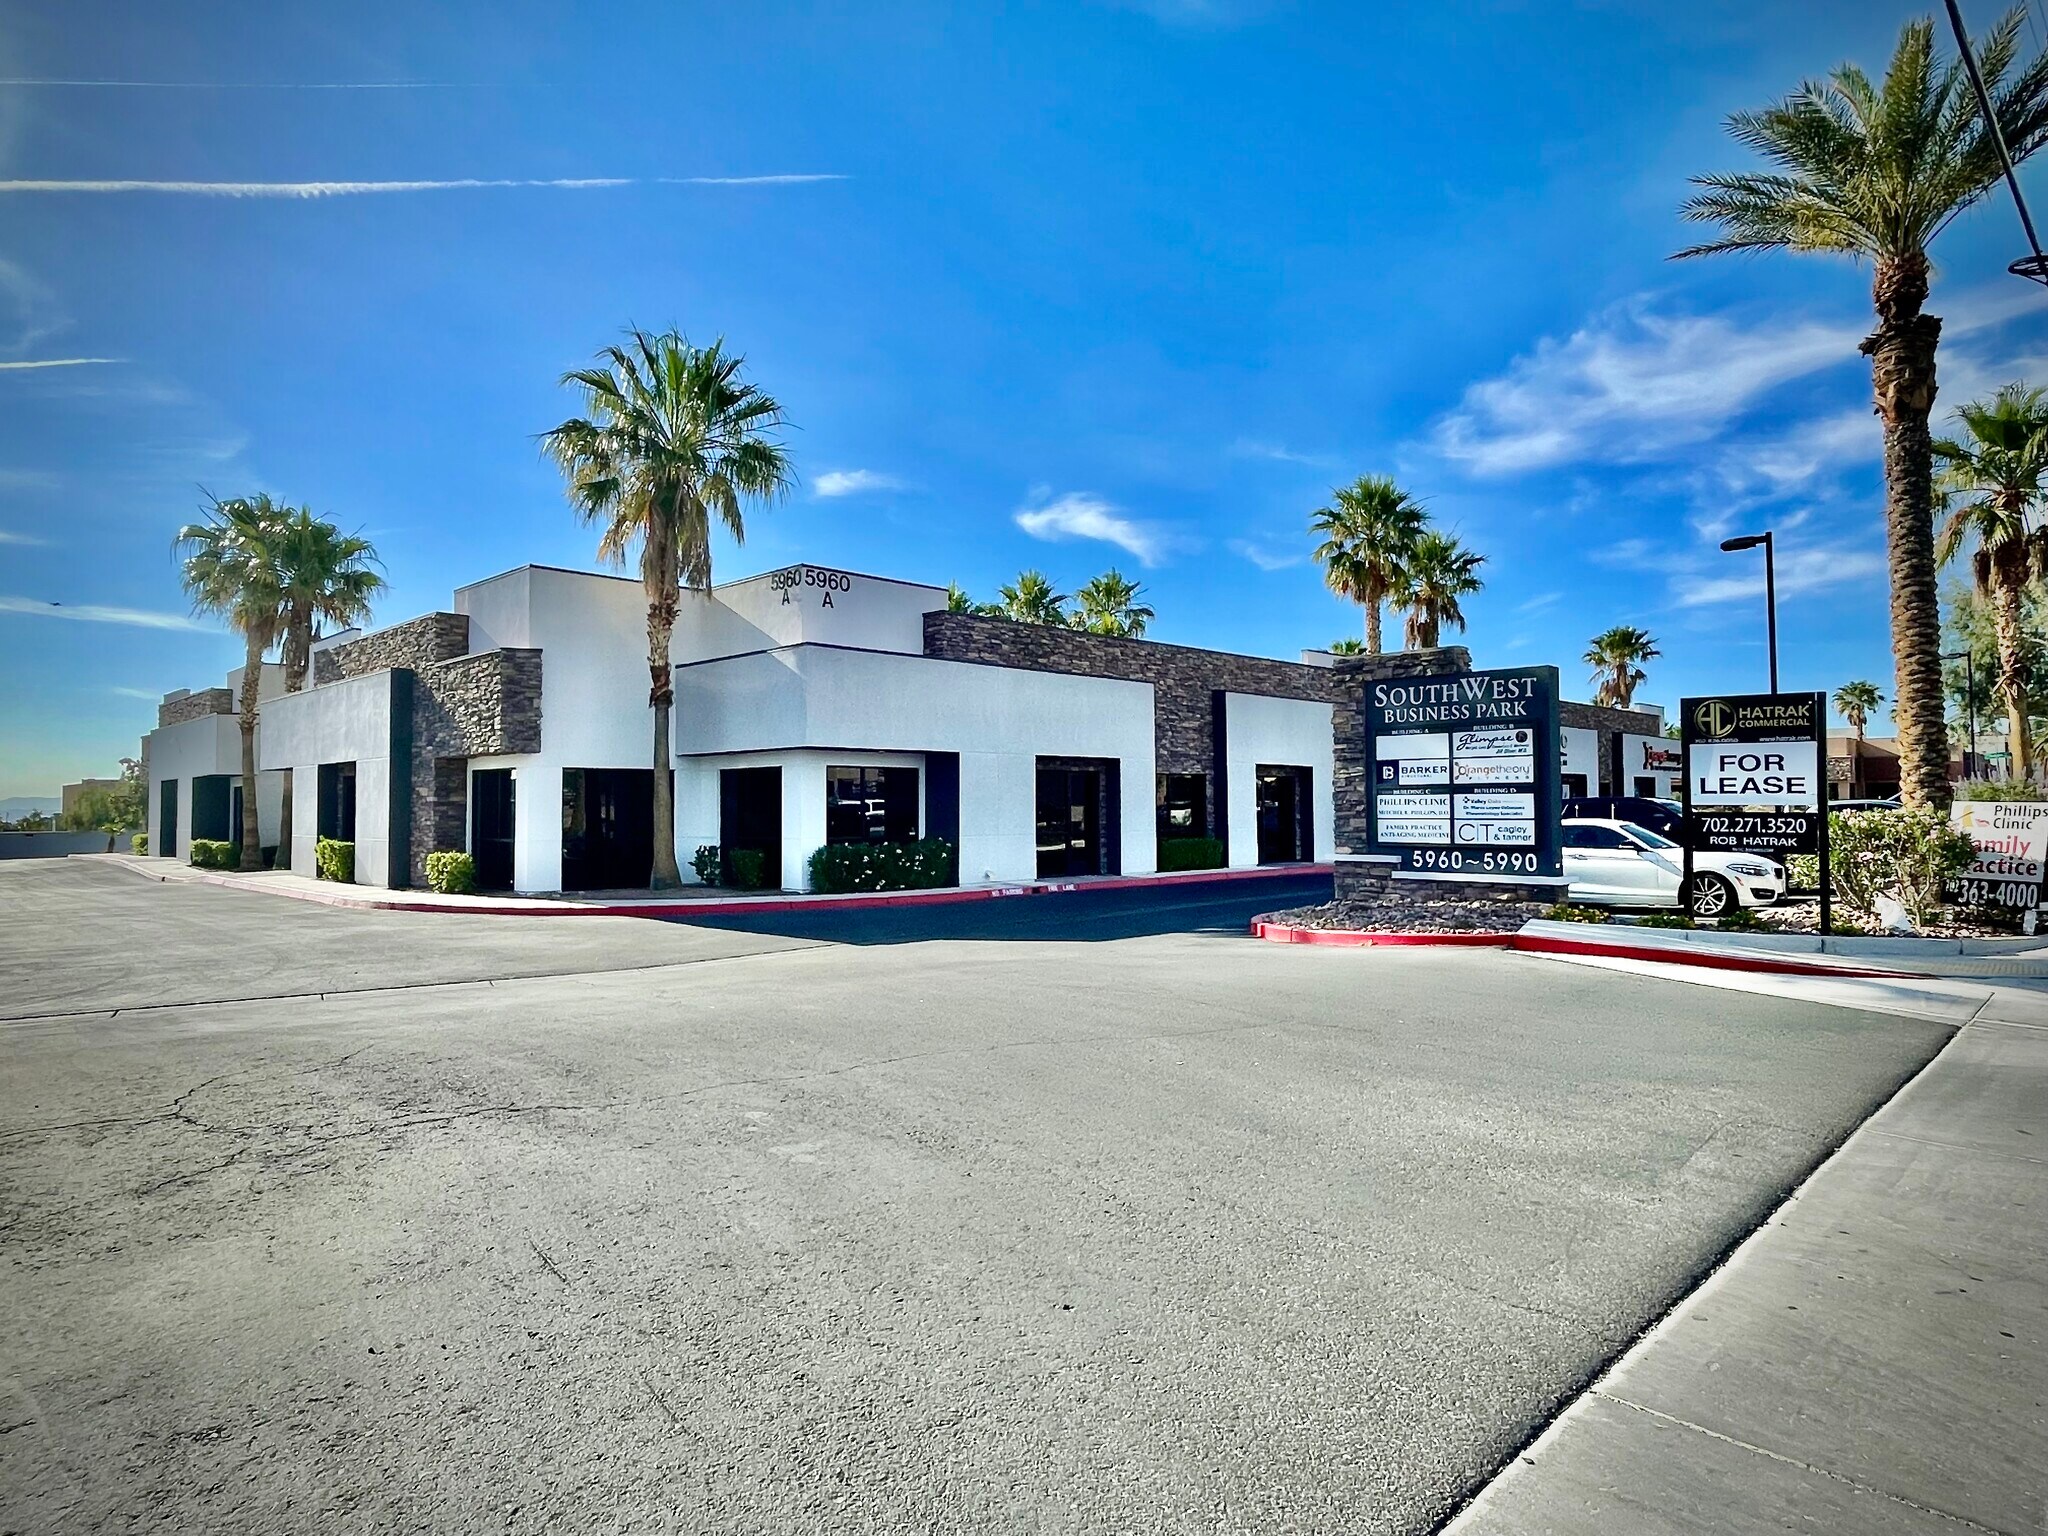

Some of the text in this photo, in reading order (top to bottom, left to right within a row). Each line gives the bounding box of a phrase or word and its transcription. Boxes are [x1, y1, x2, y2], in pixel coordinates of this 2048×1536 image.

[771, 569, 801, 591] 5960
[804, 569, 850, 592] 5960
[782, 589, 790, 606] A
[822, 591, 834, 608] A
[1384, 701, 1527, 723] BUSINESS PARK
[1739, 705, 1810, 719] HATRAK
[1739, 718, 1810, 728] COMMERCIAL
[1456, 733, 1514, 751] Glimpse
[1401, 766, 1448, 774] BARKER
[1719, 754, 1785, 772] FOR
[1700, 776, 1807, 795] LEASE
[1994, 805, 2048, 819] Phillips
[1498, 826, 1527, 834] cagley
[1702, 817, 1807, 834] 702.271.3520
[1993, 818, 2033, 830] Clinic
[1710, 836, 1797, 847] ROB HATRAK
[1972, 835, 2031, 860] amily
[1973, 856, 2037, 876] actice
[1958, 880, 2038, 908] 363-4000
